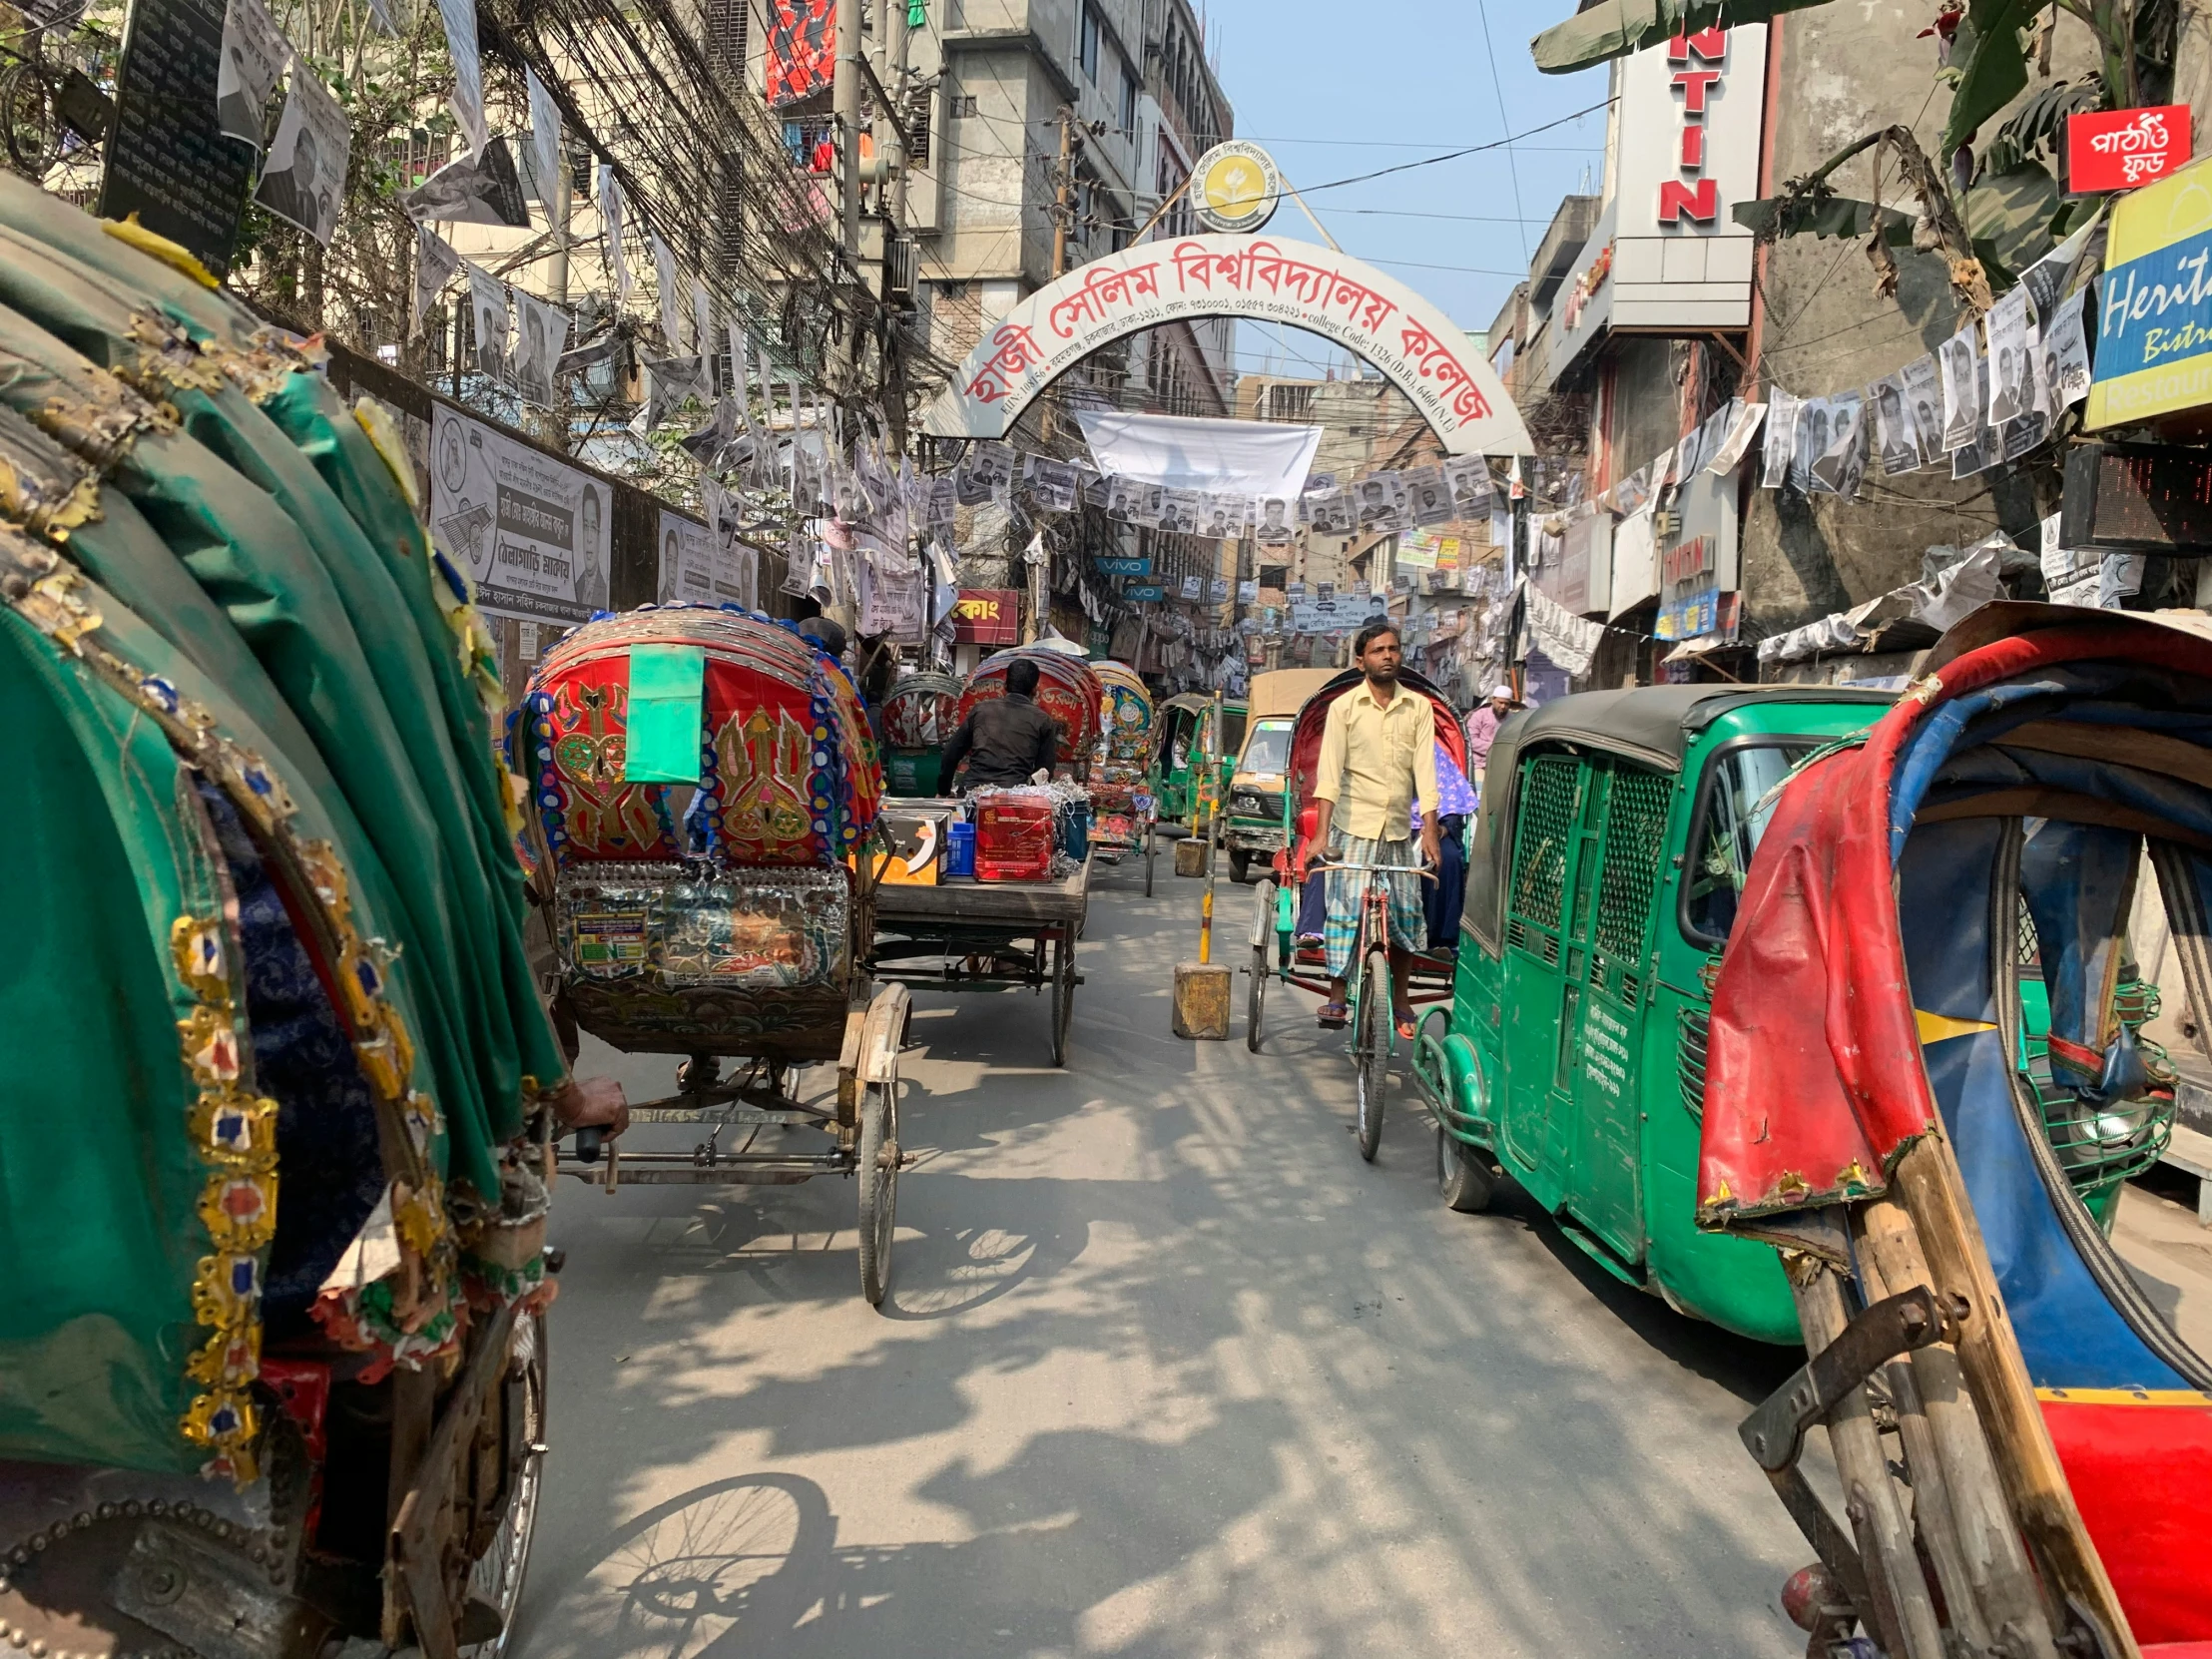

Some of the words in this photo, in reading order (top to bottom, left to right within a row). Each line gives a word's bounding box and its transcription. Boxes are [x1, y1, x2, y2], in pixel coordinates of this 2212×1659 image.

[2090, 115, 2170, 154] পাঠাও
[2122, 152, 2168, 182] ফুড
[2102, 247, 2212, 338] Herit
[963, 324, 1045, 404] হাজী
[1049, 264, 1161, 338] সেলিম
[1169, 242, 1398, 335] বিশ্ববিদ্যালয়
[1400, 314, 1493, 428] কলেজ
[1021, 367, 1047, 395] 108156
[1083, 322, 1120, 345] চকবাজার,
[1120, 306, 1164, 328] ঢাকা-১২১১,
[1189, 297, 1233, 310] ৭৩১০০০১,
[1308, 313, 1341, 334] college
[1342, 325, 1369, 349] Code:
[1370, 342, 1391, 364] 1326
[1415, 384, 1438, 407] 6460
[498, 535, 540, 576] ঠেলাগাড়ি
[543, 551, 570, 585] মার্কায়
[1104, 559, 1142, 571] vivo
[493, 590, 514, 606] হাসান
[1123, 587, 1154, 597] vivo
[1090, 631, 1109, 644] oppo
